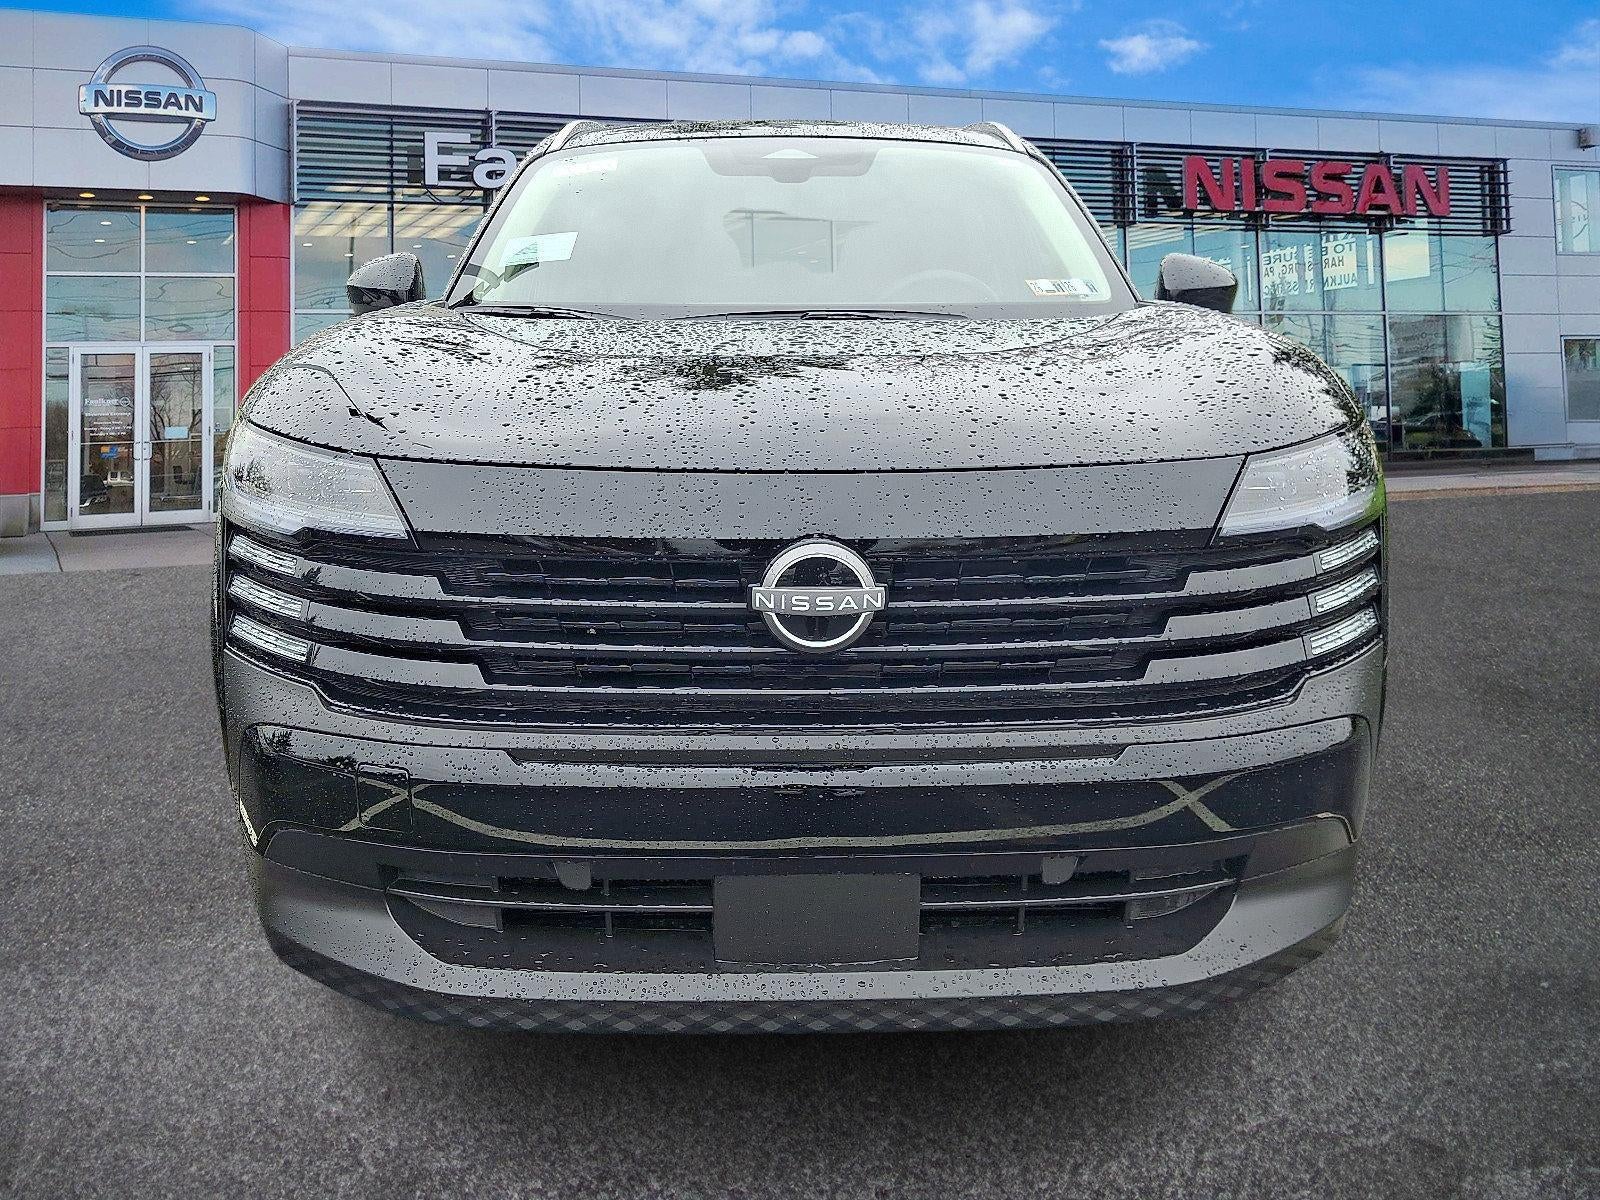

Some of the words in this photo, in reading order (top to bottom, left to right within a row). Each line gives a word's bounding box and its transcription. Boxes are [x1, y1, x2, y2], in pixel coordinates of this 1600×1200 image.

[93, 89, 204, 113] NISSAN
[1182, 154, 1451, 217] NISSAN
[754, 592, 882, 612] NISSAN
